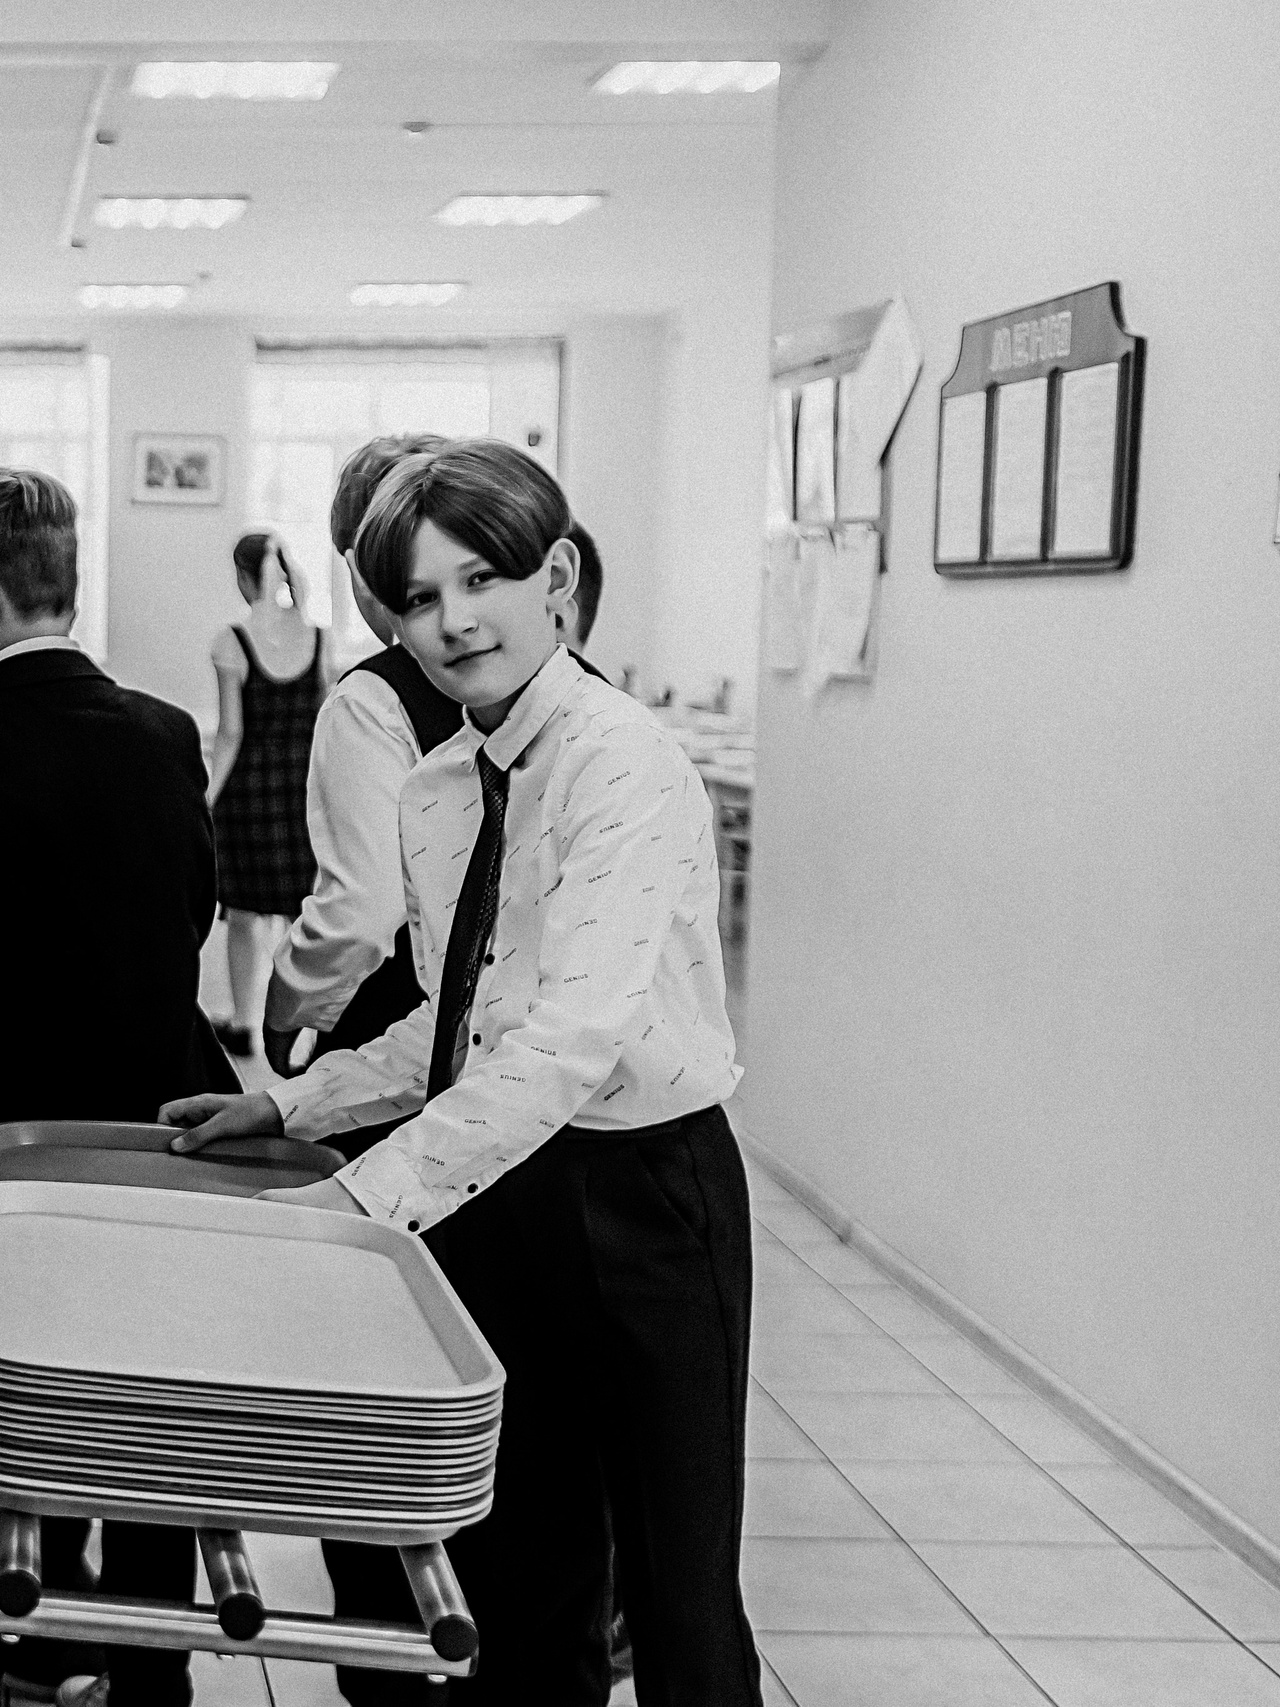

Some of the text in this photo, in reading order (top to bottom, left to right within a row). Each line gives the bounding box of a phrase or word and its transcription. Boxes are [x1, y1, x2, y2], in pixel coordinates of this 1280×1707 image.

[607, 771, 630, 785] GENIUS
[563, 973, 588, 983] GENIUS
[500, 1074, 527, 1083] GENIUS
